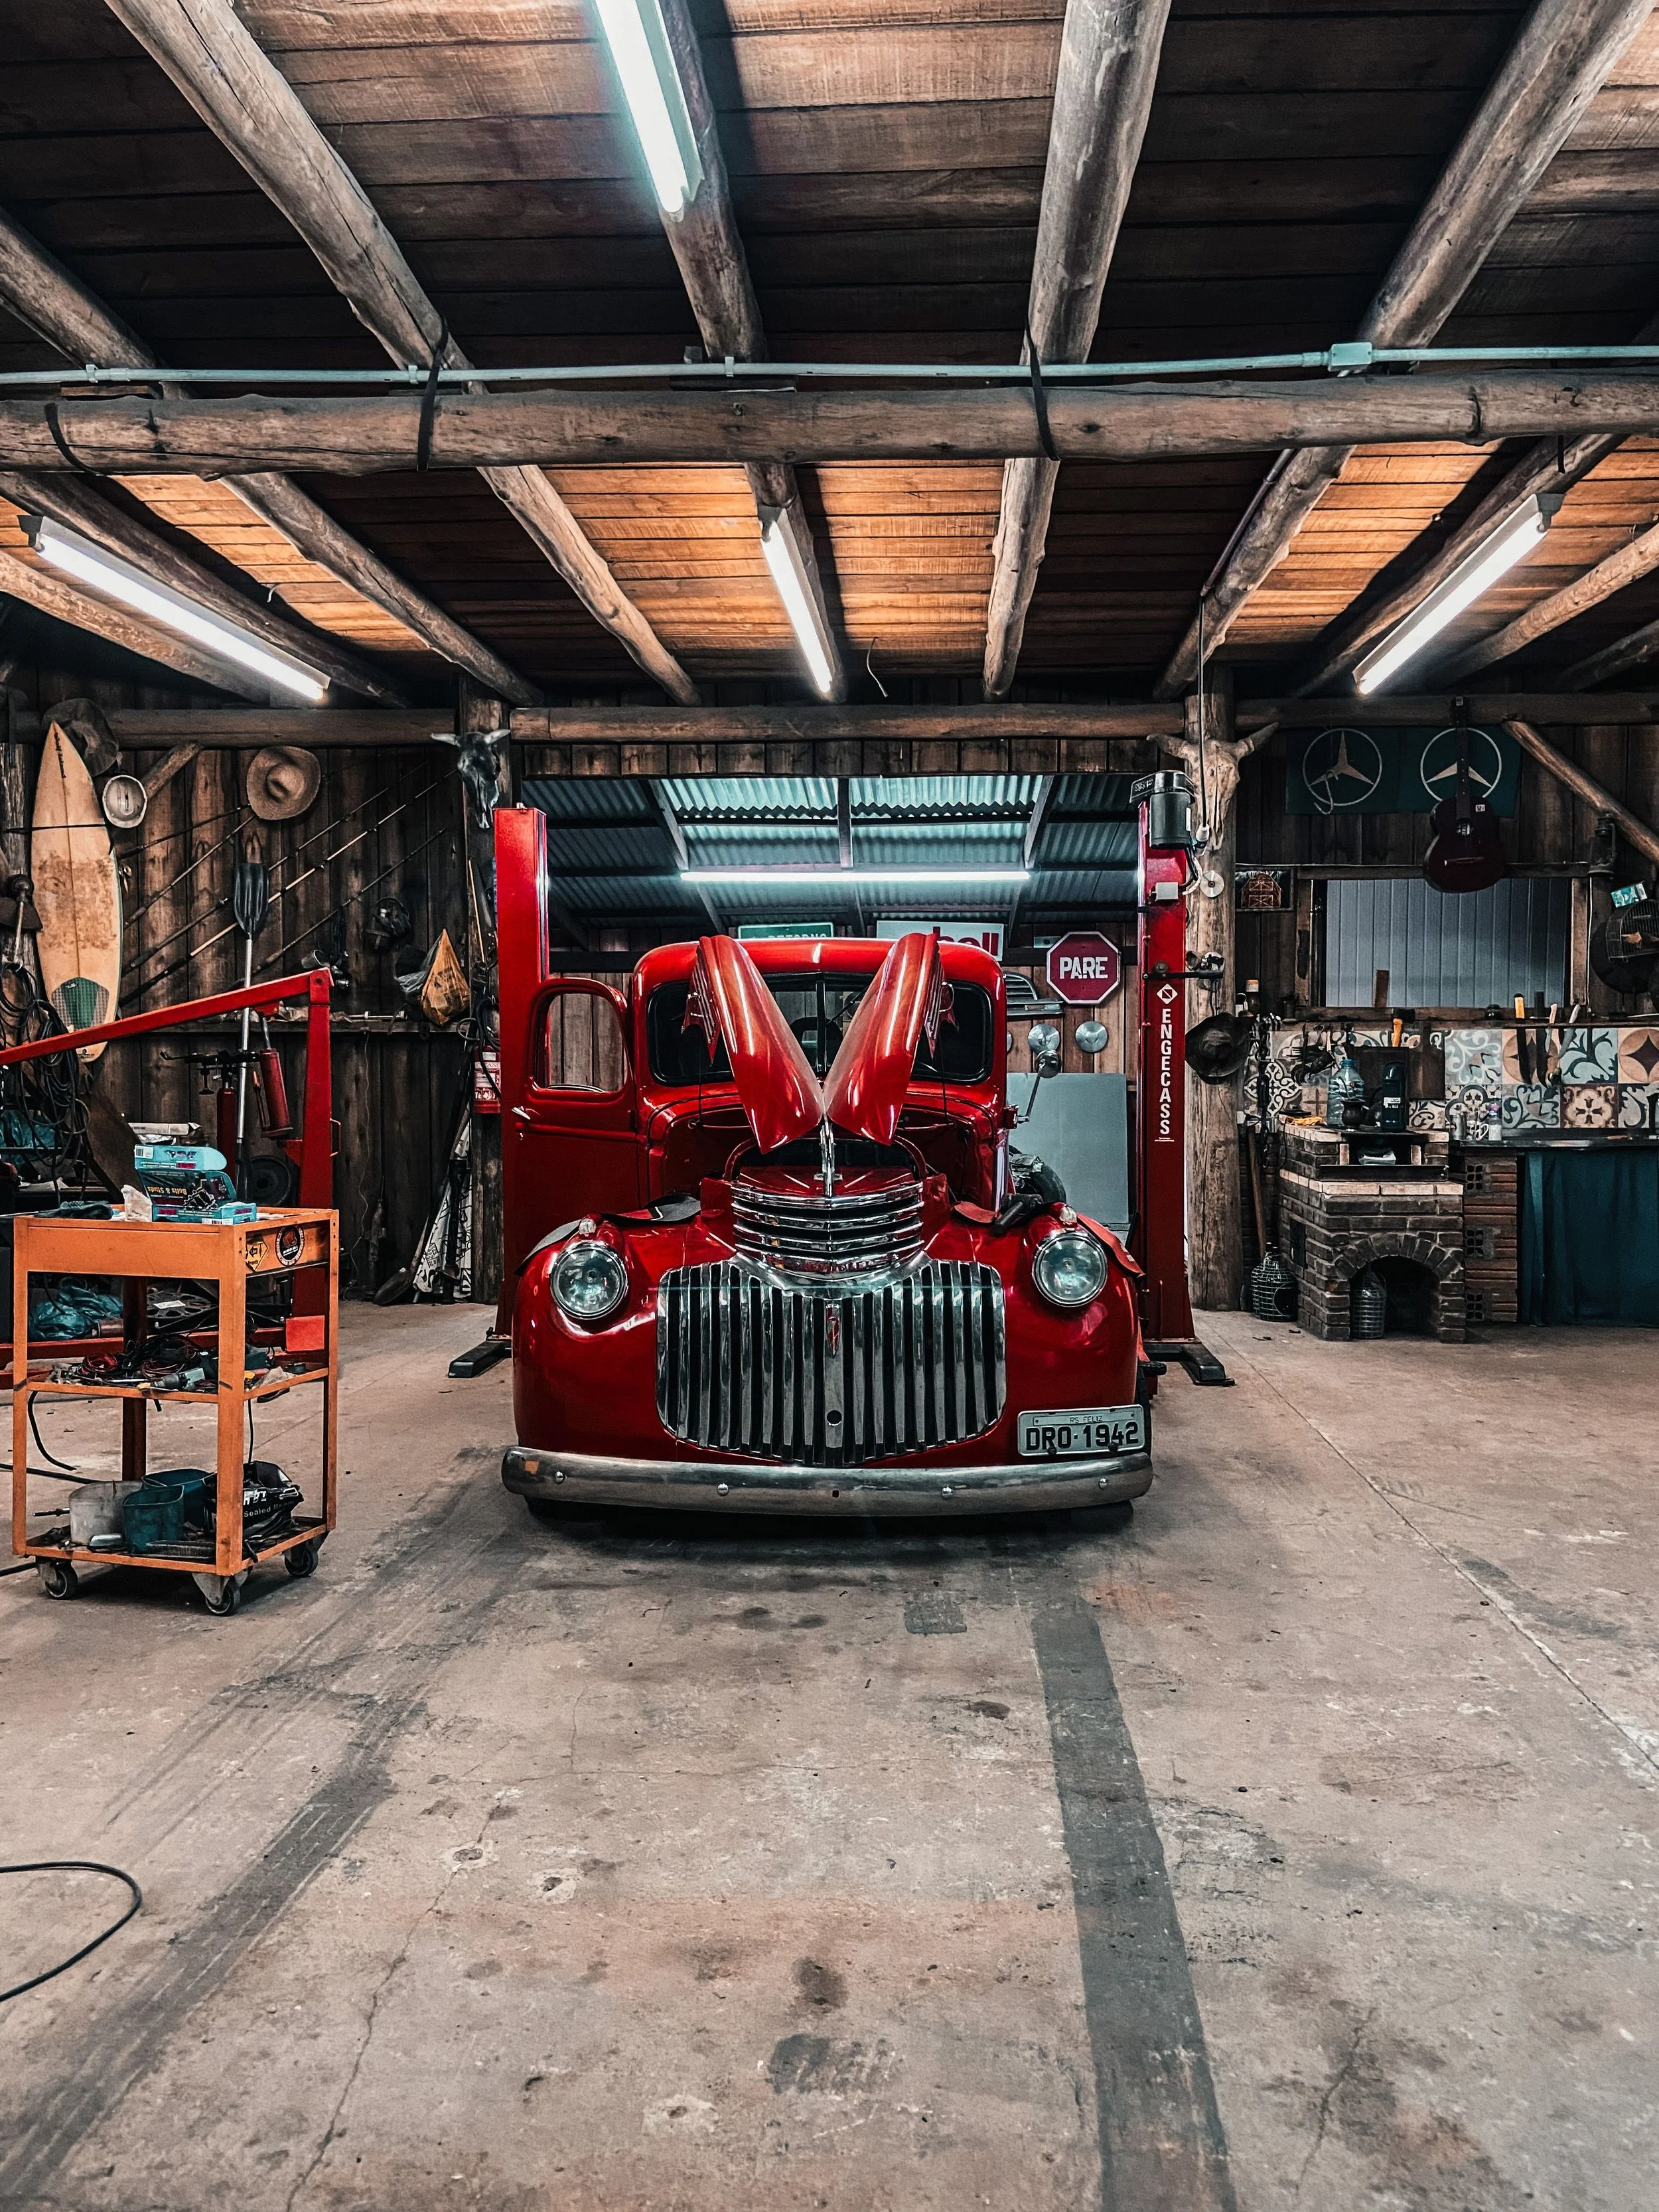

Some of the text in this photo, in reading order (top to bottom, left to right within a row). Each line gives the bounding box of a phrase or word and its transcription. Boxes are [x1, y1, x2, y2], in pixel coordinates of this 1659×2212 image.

[1059, 956, 1108, 980] PARE
[1159, 1008, 1173, 1135] ENGECASS
[795, 1258, 874, 1274] ROLET
[244, 1506, 271, 1517] Sealed
